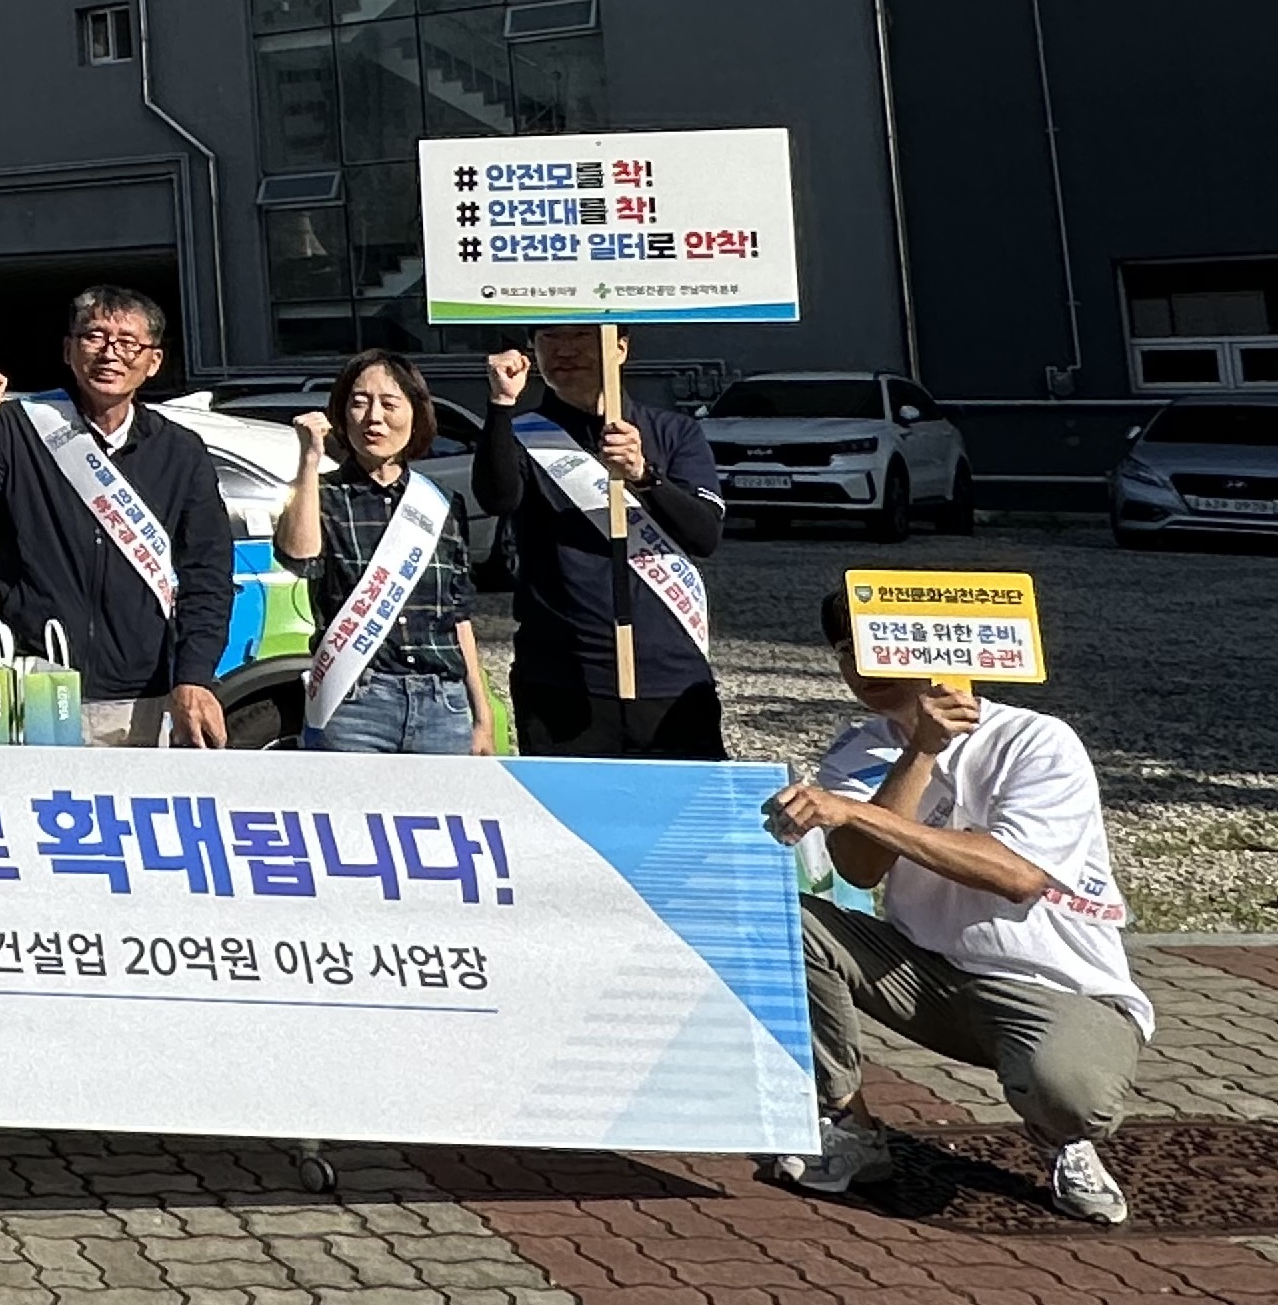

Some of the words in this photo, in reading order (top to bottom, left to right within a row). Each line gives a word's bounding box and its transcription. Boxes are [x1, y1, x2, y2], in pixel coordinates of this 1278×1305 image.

[486, 161, 604, 191] 안전모를
[612, 160, 654, 188] 착!
[488, 197, 608, 226] 안전대를
[615, 196, 657, 224] 착!
[490, 233, 581, 262] 안전한
[587, 232, 677, 261] 일터로
[684, 230, 760, 259] 안착!
[86, 452, 116, 488] 8월
[112, 487, 145, 525] 18일
[399, 546, 424, 583] 8월
[376, 581, 407, 622] 18일
[878, 585, 1024, 605] 안전문화실천추진단
[327, 615, 361, 657] 설치
[351, 619, 384, 656] 부터
[869, 621, 928, 642] 안전을
[932, 623, 972, 643] 위한
[976, 624, 1023, 646] 준비,
[872, 645, 973, 666] 일상에서의
[977, 648, 1024, 669] 습관!
[29, 790, 515, 906] 확대됩니다!
[123, 934, 260, 983] 20억원
[275, 939, 353, 986] 이상
[369, 943, 490, 992] 사업장
